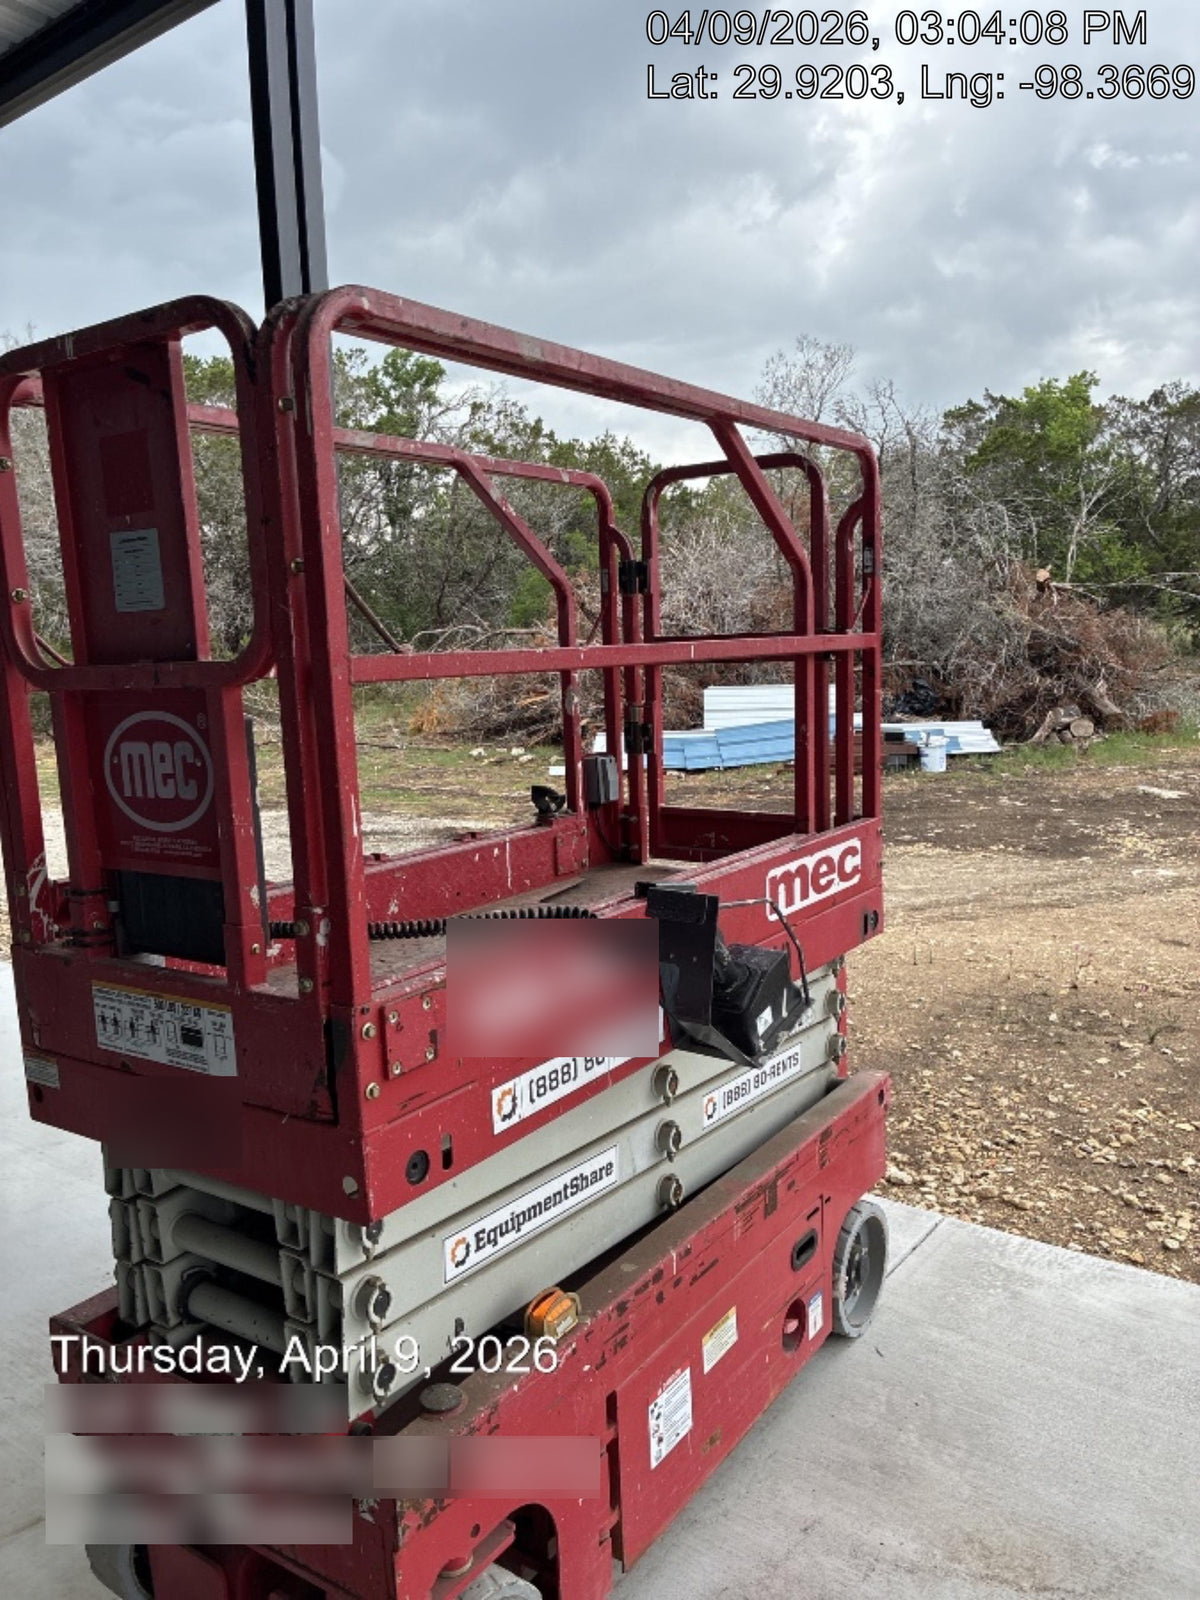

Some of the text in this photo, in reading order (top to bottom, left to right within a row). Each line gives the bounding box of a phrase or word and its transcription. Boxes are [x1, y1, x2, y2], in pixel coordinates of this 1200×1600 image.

[768, 845, 861, 915] mec
[529, 1057, 578, 1104] (888)
[473, 1161, 614, 1253] EquipmentShare
